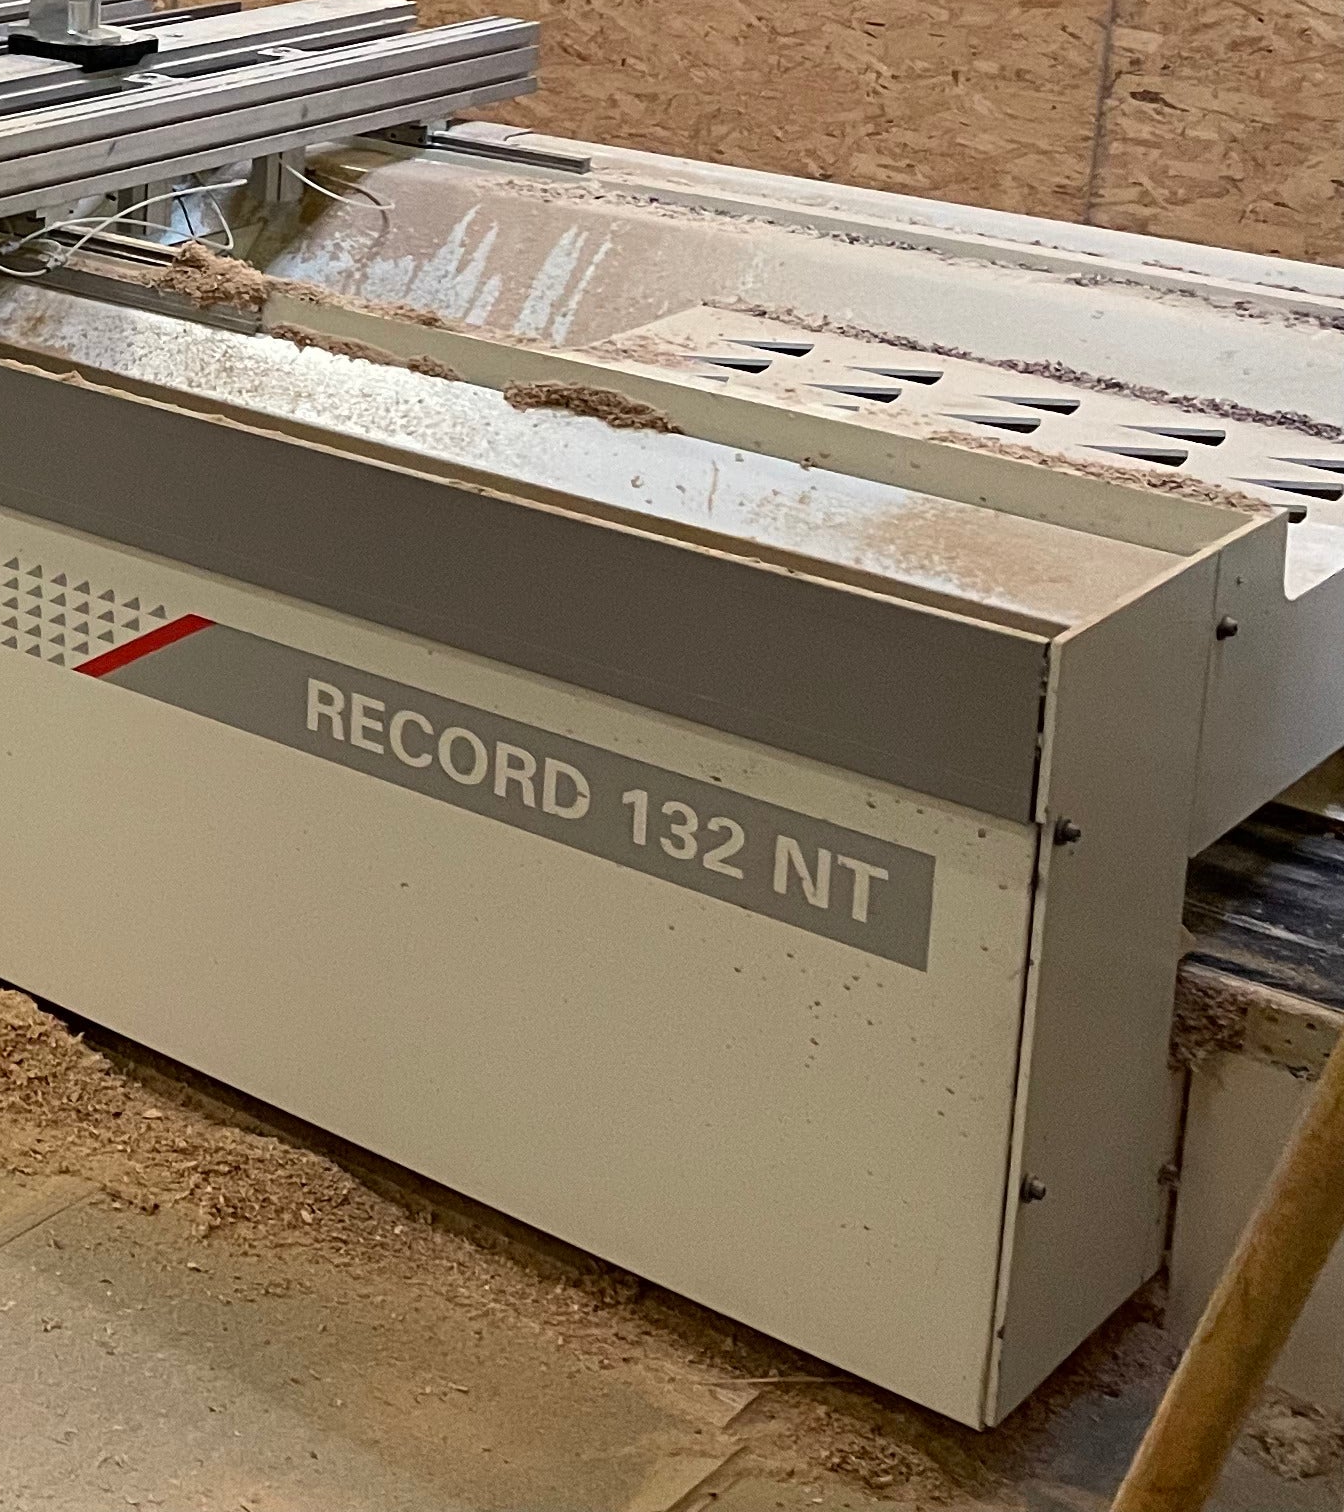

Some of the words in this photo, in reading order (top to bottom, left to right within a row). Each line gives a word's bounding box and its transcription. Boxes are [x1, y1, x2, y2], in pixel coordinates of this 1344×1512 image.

[305, 677, 592, 822] RECORD
[620, 788, 746, 880] 132
[773, 834, 890, 924] NT
